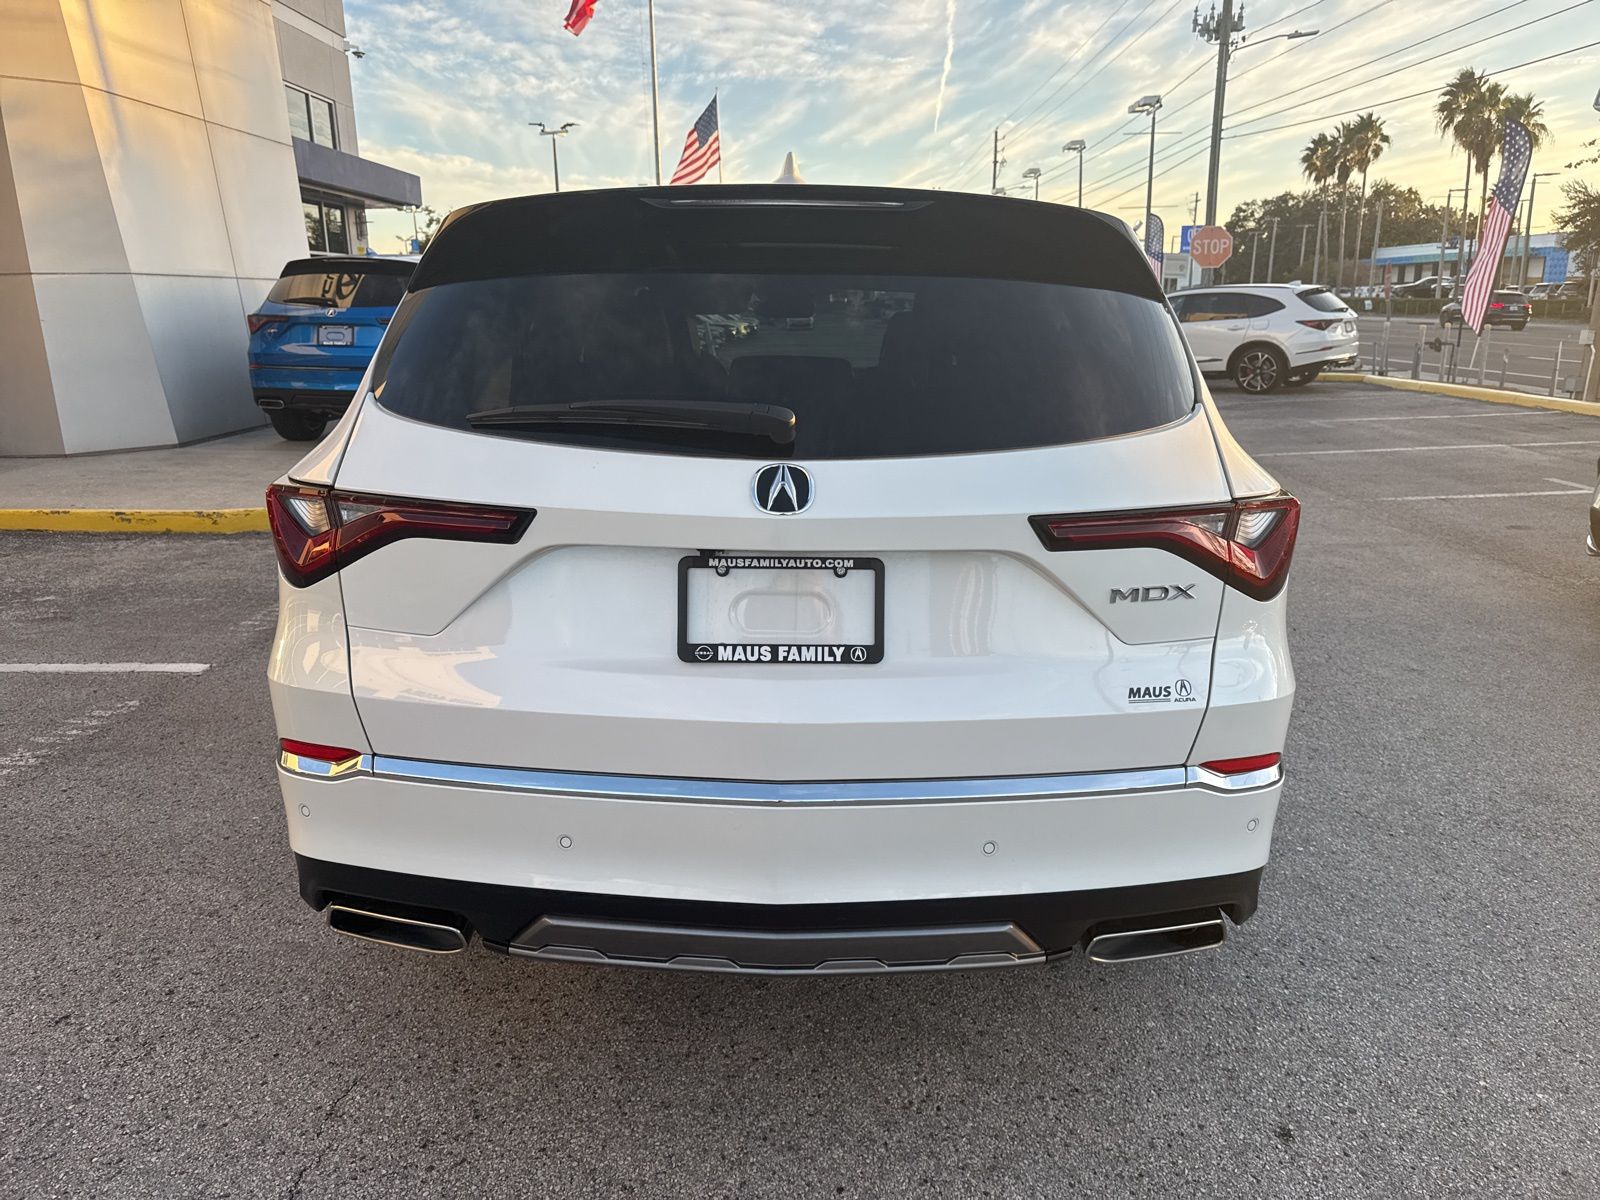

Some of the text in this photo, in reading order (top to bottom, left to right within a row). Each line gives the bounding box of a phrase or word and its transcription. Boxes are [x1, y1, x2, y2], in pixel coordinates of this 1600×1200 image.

[1193, 239, 1229, 255] STOP
[708, 558, 854, 568] MAUSFAMILYAUTO.COM
[1109, 583, 1196, 604] MDX
[717, 646, 845, 662] MAUS FAMILY
[1128, 686, 1171, 699] MAUS
